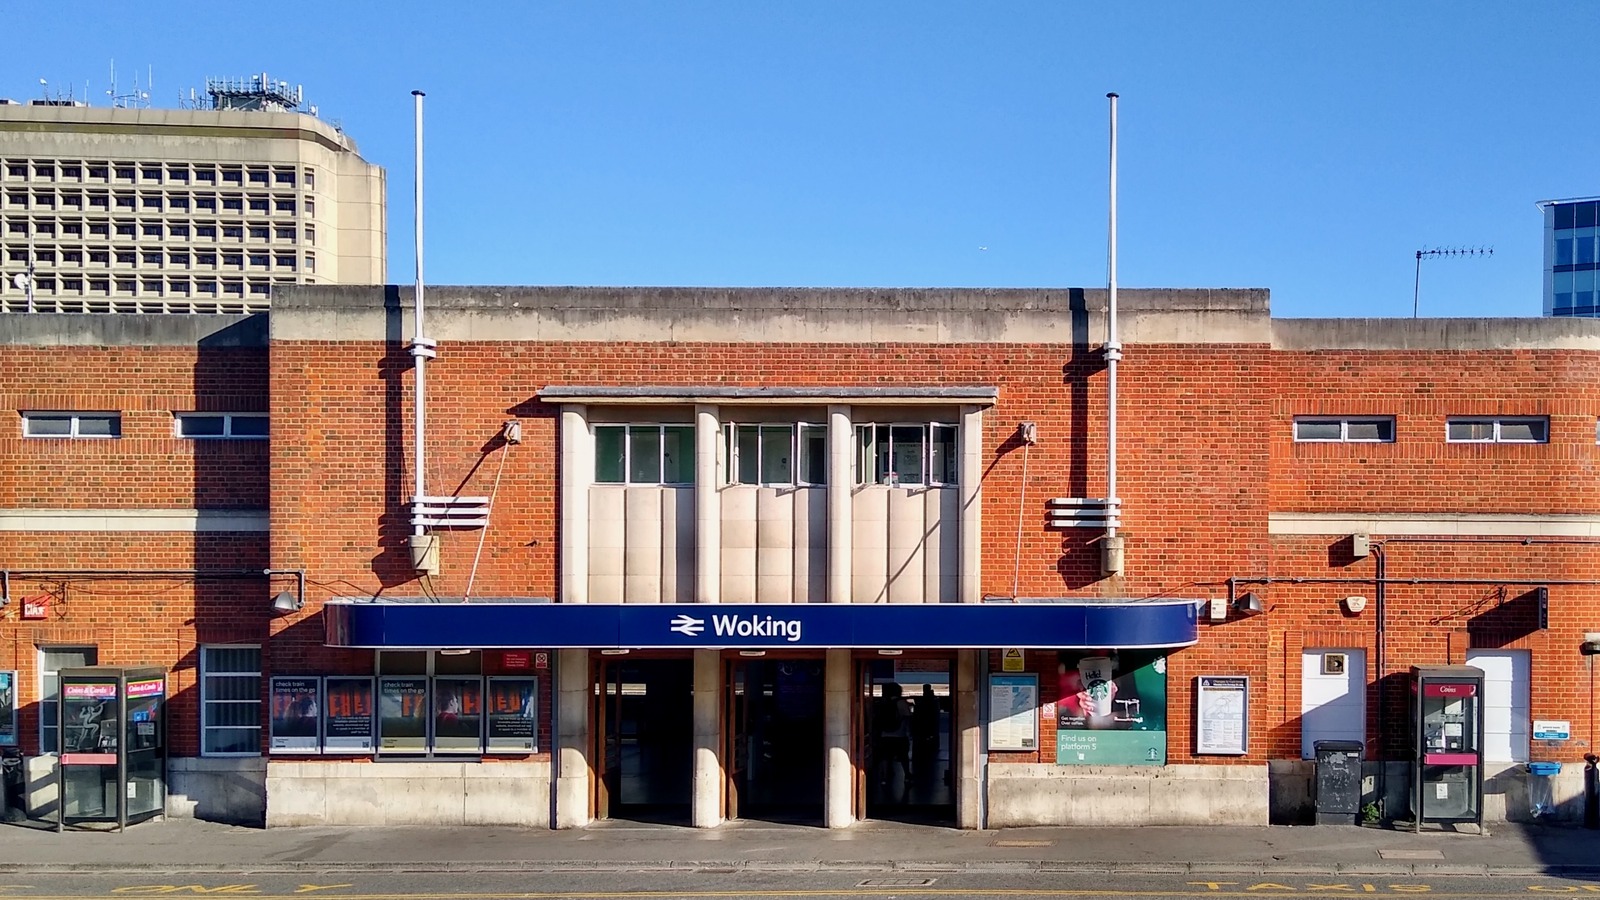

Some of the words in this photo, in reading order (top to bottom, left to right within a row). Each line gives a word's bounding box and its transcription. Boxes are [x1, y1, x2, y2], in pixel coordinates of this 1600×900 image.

[712, 614, 801, 641] Woking
[67, 686, 83, 694] Coins
[89, 686, 107, 694] Cards
[1439, 685, 1457, 693] Coins
[1061, 743, 1091, 751] platform
[1186, 881, 1432, 892] TAXIS
